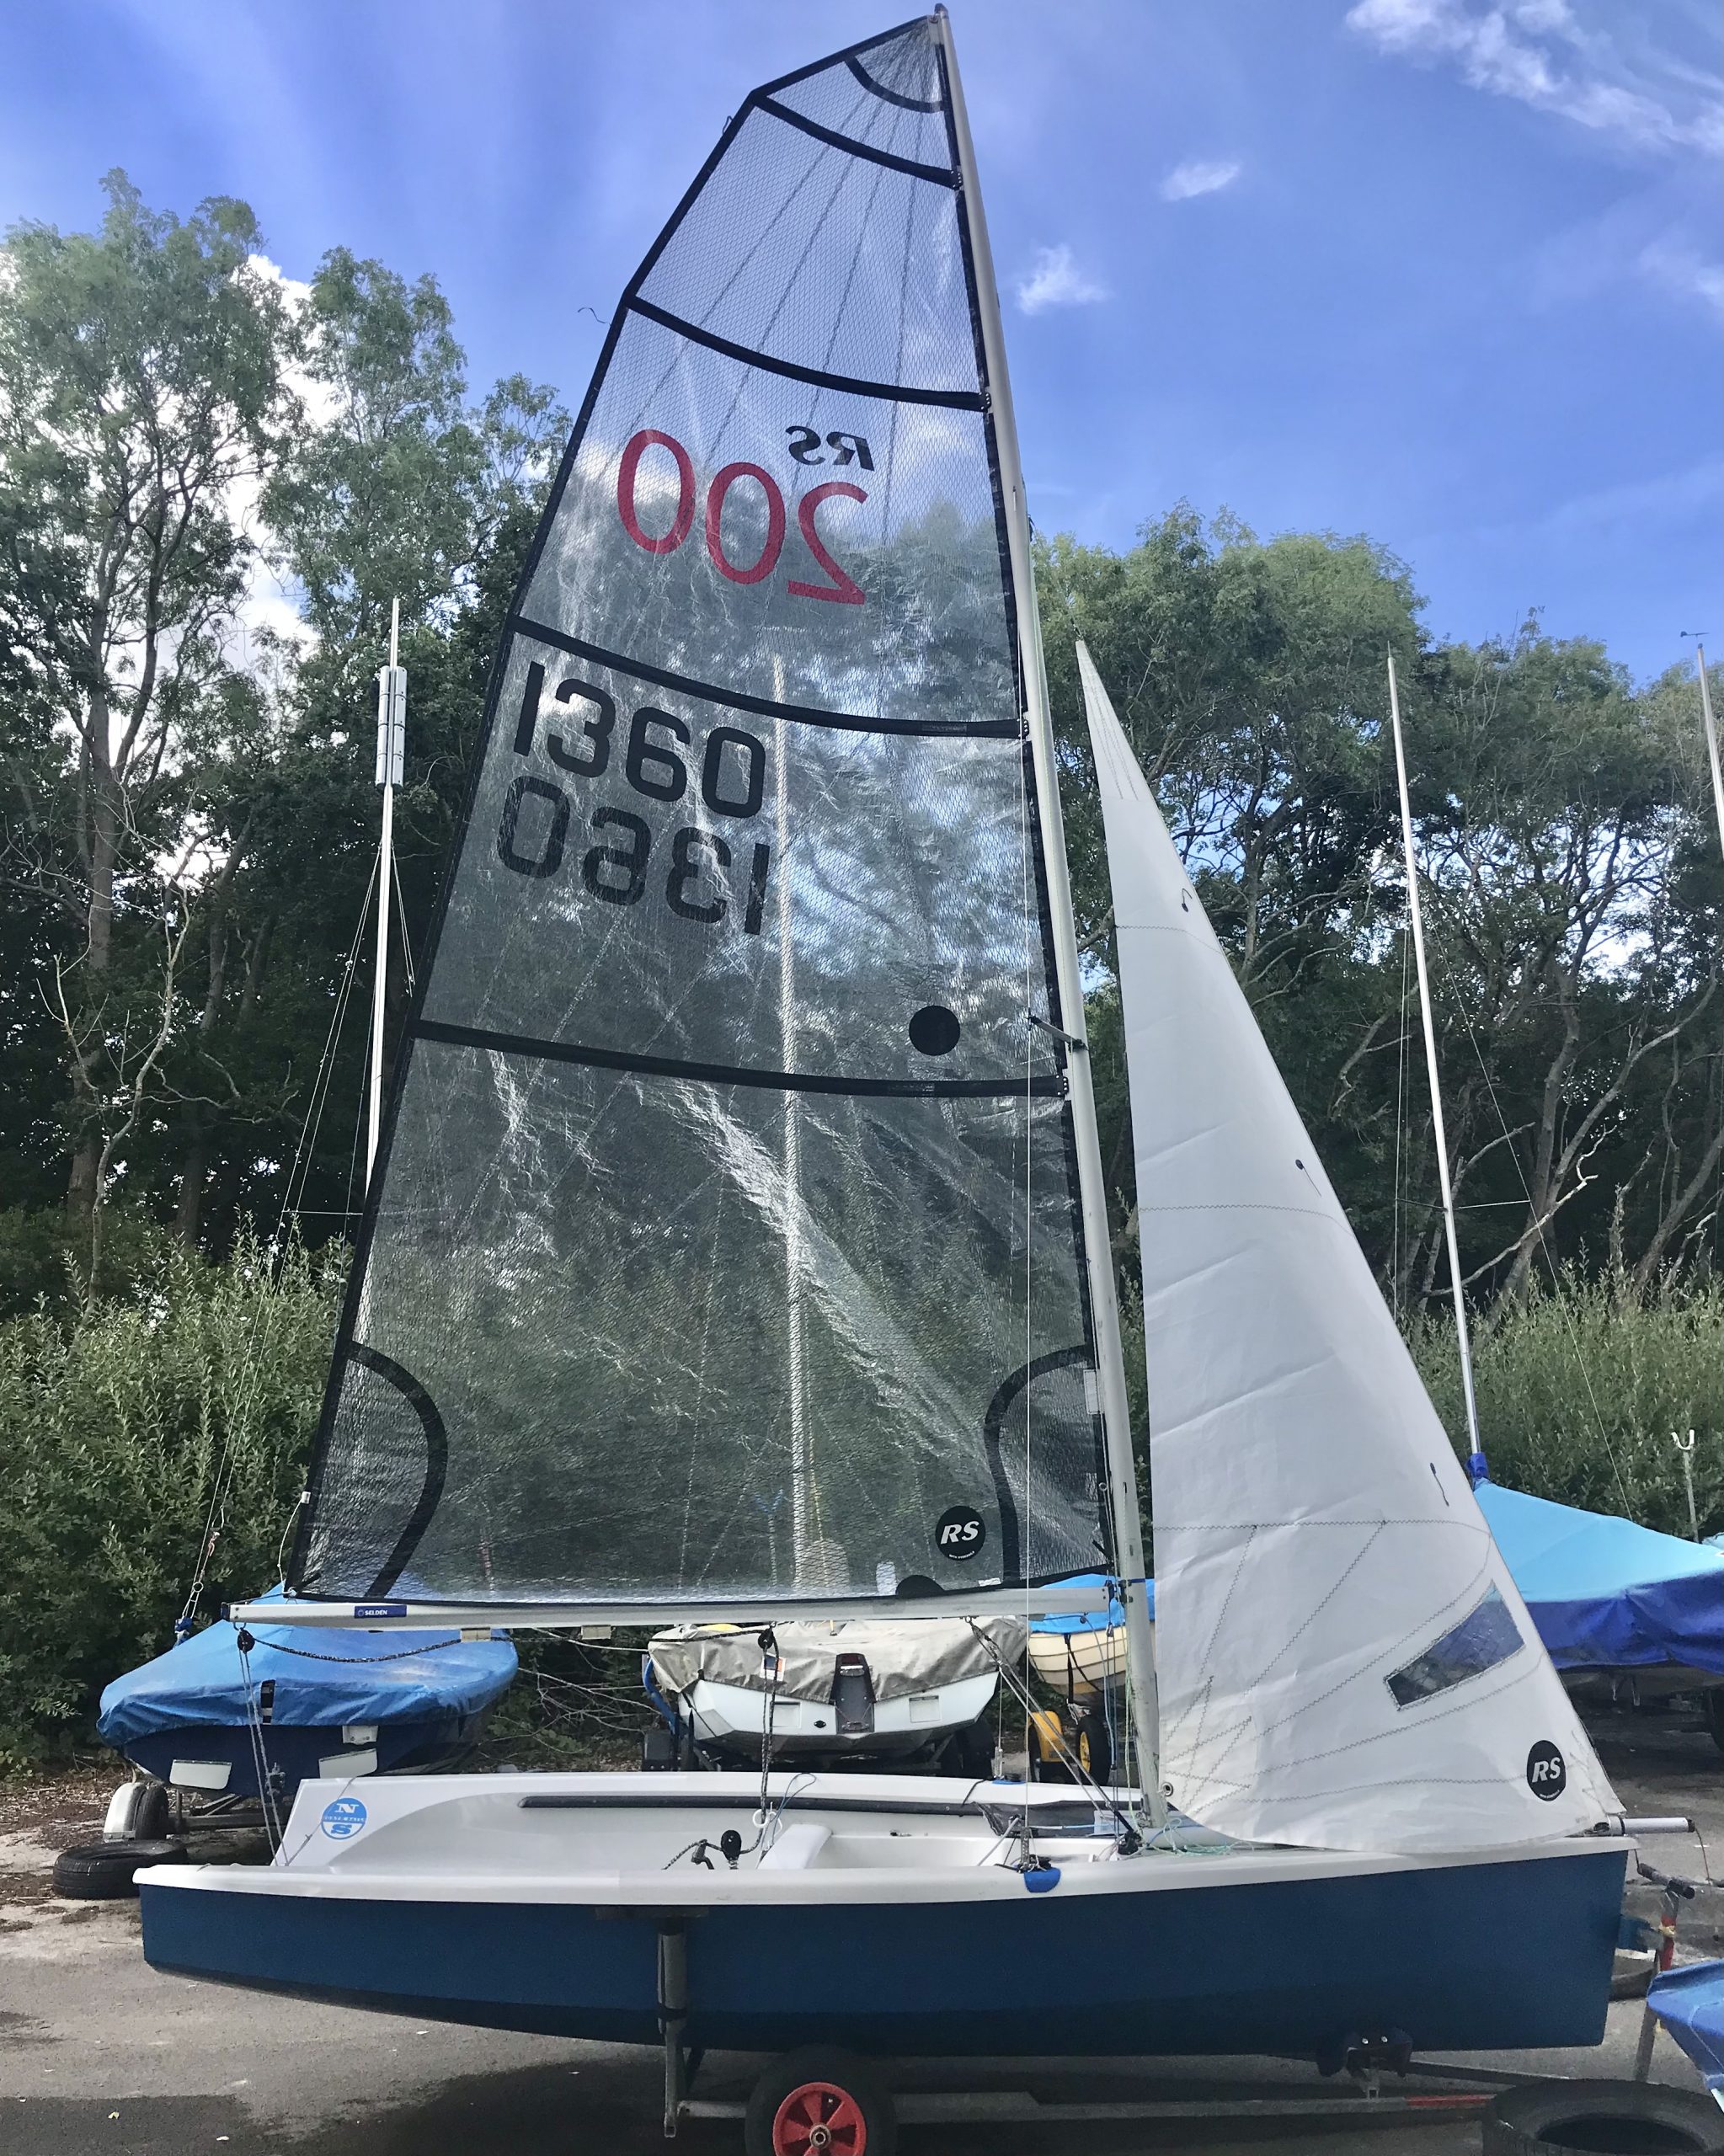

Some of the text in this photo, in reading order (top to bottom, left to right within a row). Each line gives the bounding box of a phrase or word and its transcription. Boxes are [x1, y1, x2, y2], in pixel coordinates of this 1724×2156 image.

[512, 661, 766, 819] 1360
[940, 1521, 979, 1545] RS
[1532, 1757, 1561, 1783] RS
[334, 1803, 360, 1813] N
[330, 1823, 352, 1834] S
